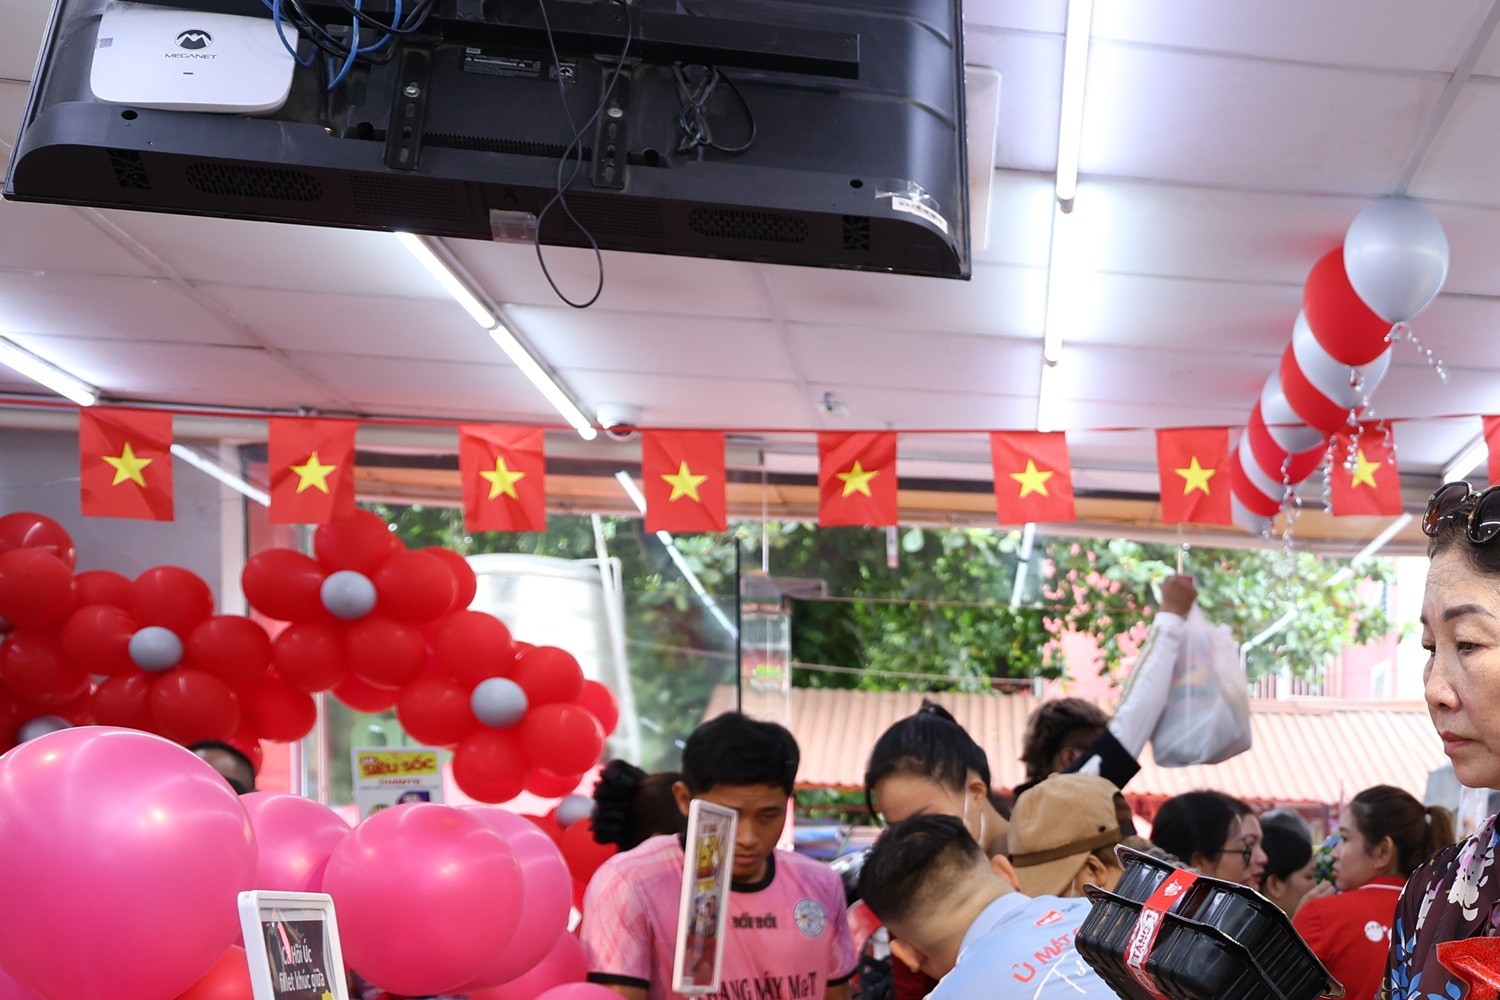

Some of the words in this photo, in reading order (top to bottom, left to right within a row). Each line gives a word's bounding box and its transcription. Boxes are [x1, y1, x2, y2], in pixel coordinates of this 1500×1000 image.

[302, 938, 312, 963] Úc
[1034, 934, 1071, 965] MÁT
[1132, 925, 1151, 959] TẶNG
[294, 967, 310, 990] khúc
[311, 968, 325, 992] giữa
[788, 971, 817, 1000] M&T
